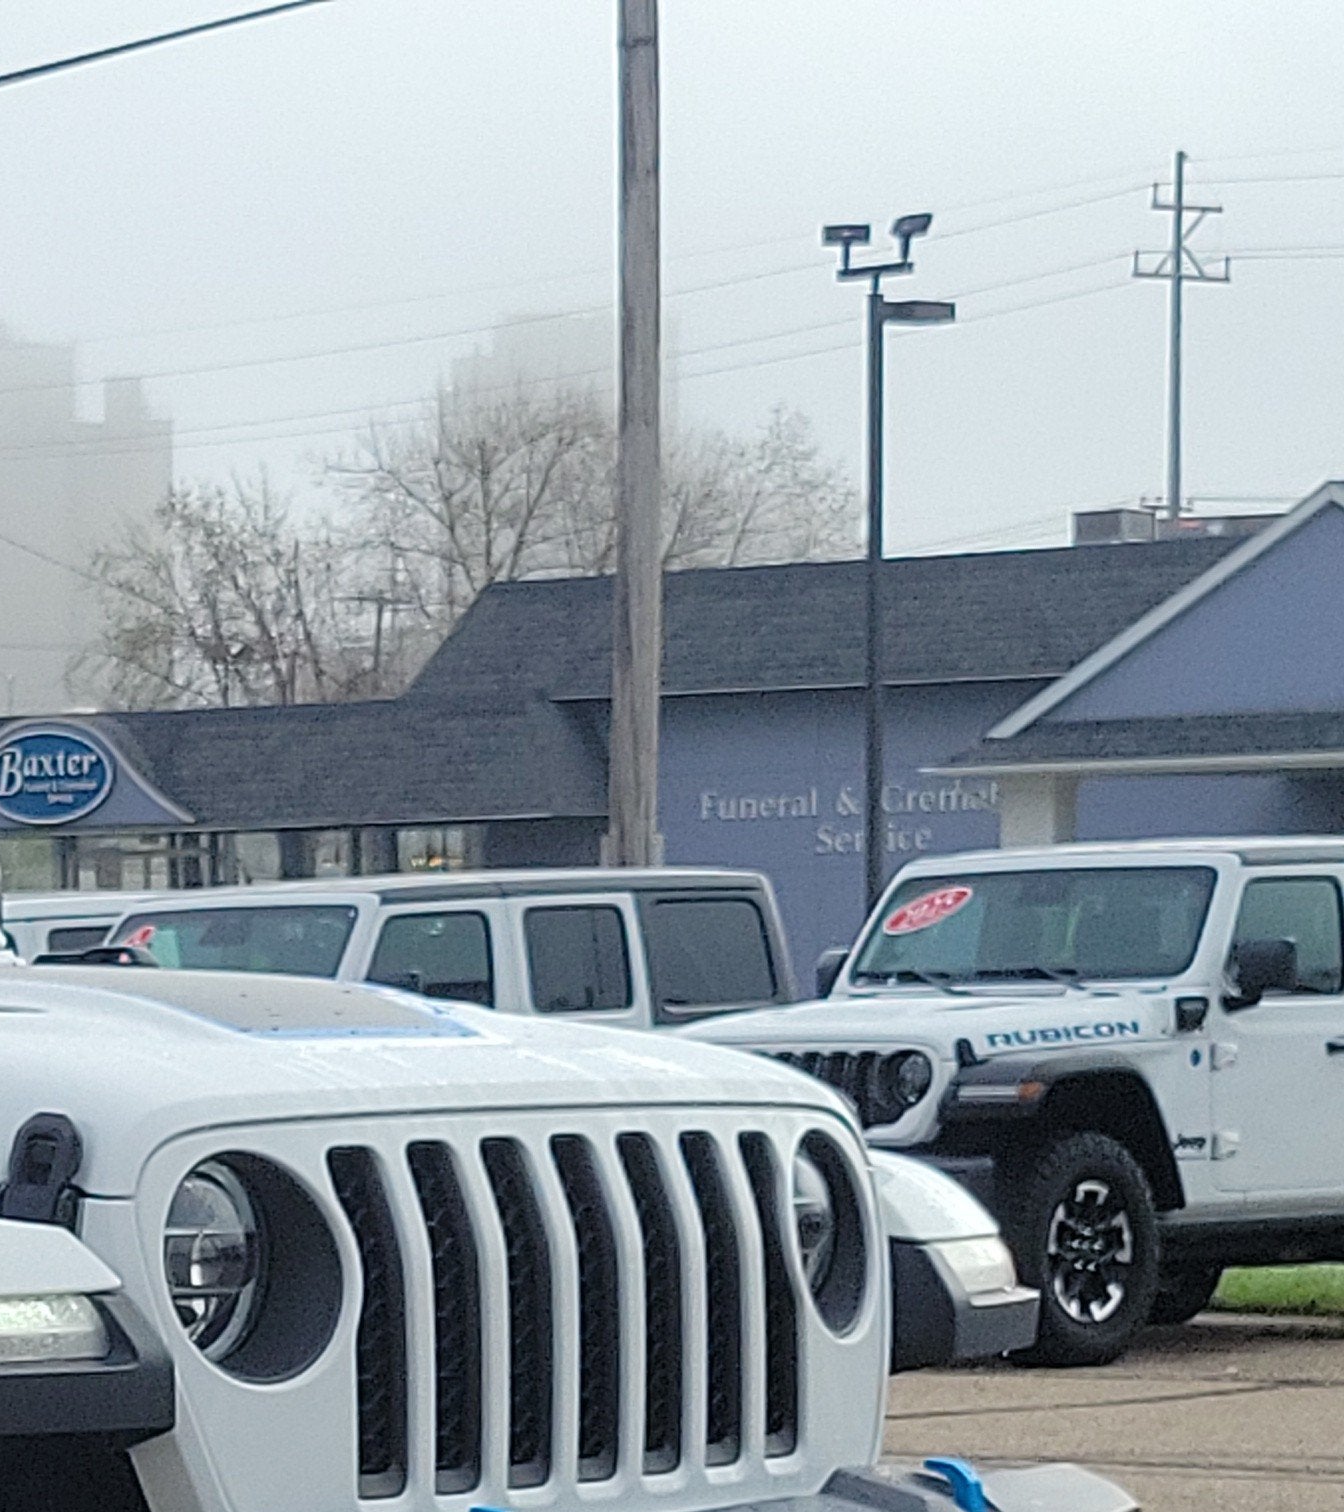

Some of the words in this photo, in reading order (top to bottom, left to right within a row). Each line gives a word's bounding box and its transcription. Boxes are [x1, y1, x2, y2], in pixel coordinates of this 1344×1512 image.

[699, 787, 818, 821] Funeral
[835, 786, 864, 816] &
[880, 779, 999, 813] Cremat
[816, 822, 932, 855] Serice
[987, 1021, 1141, 1047] RUBICON
